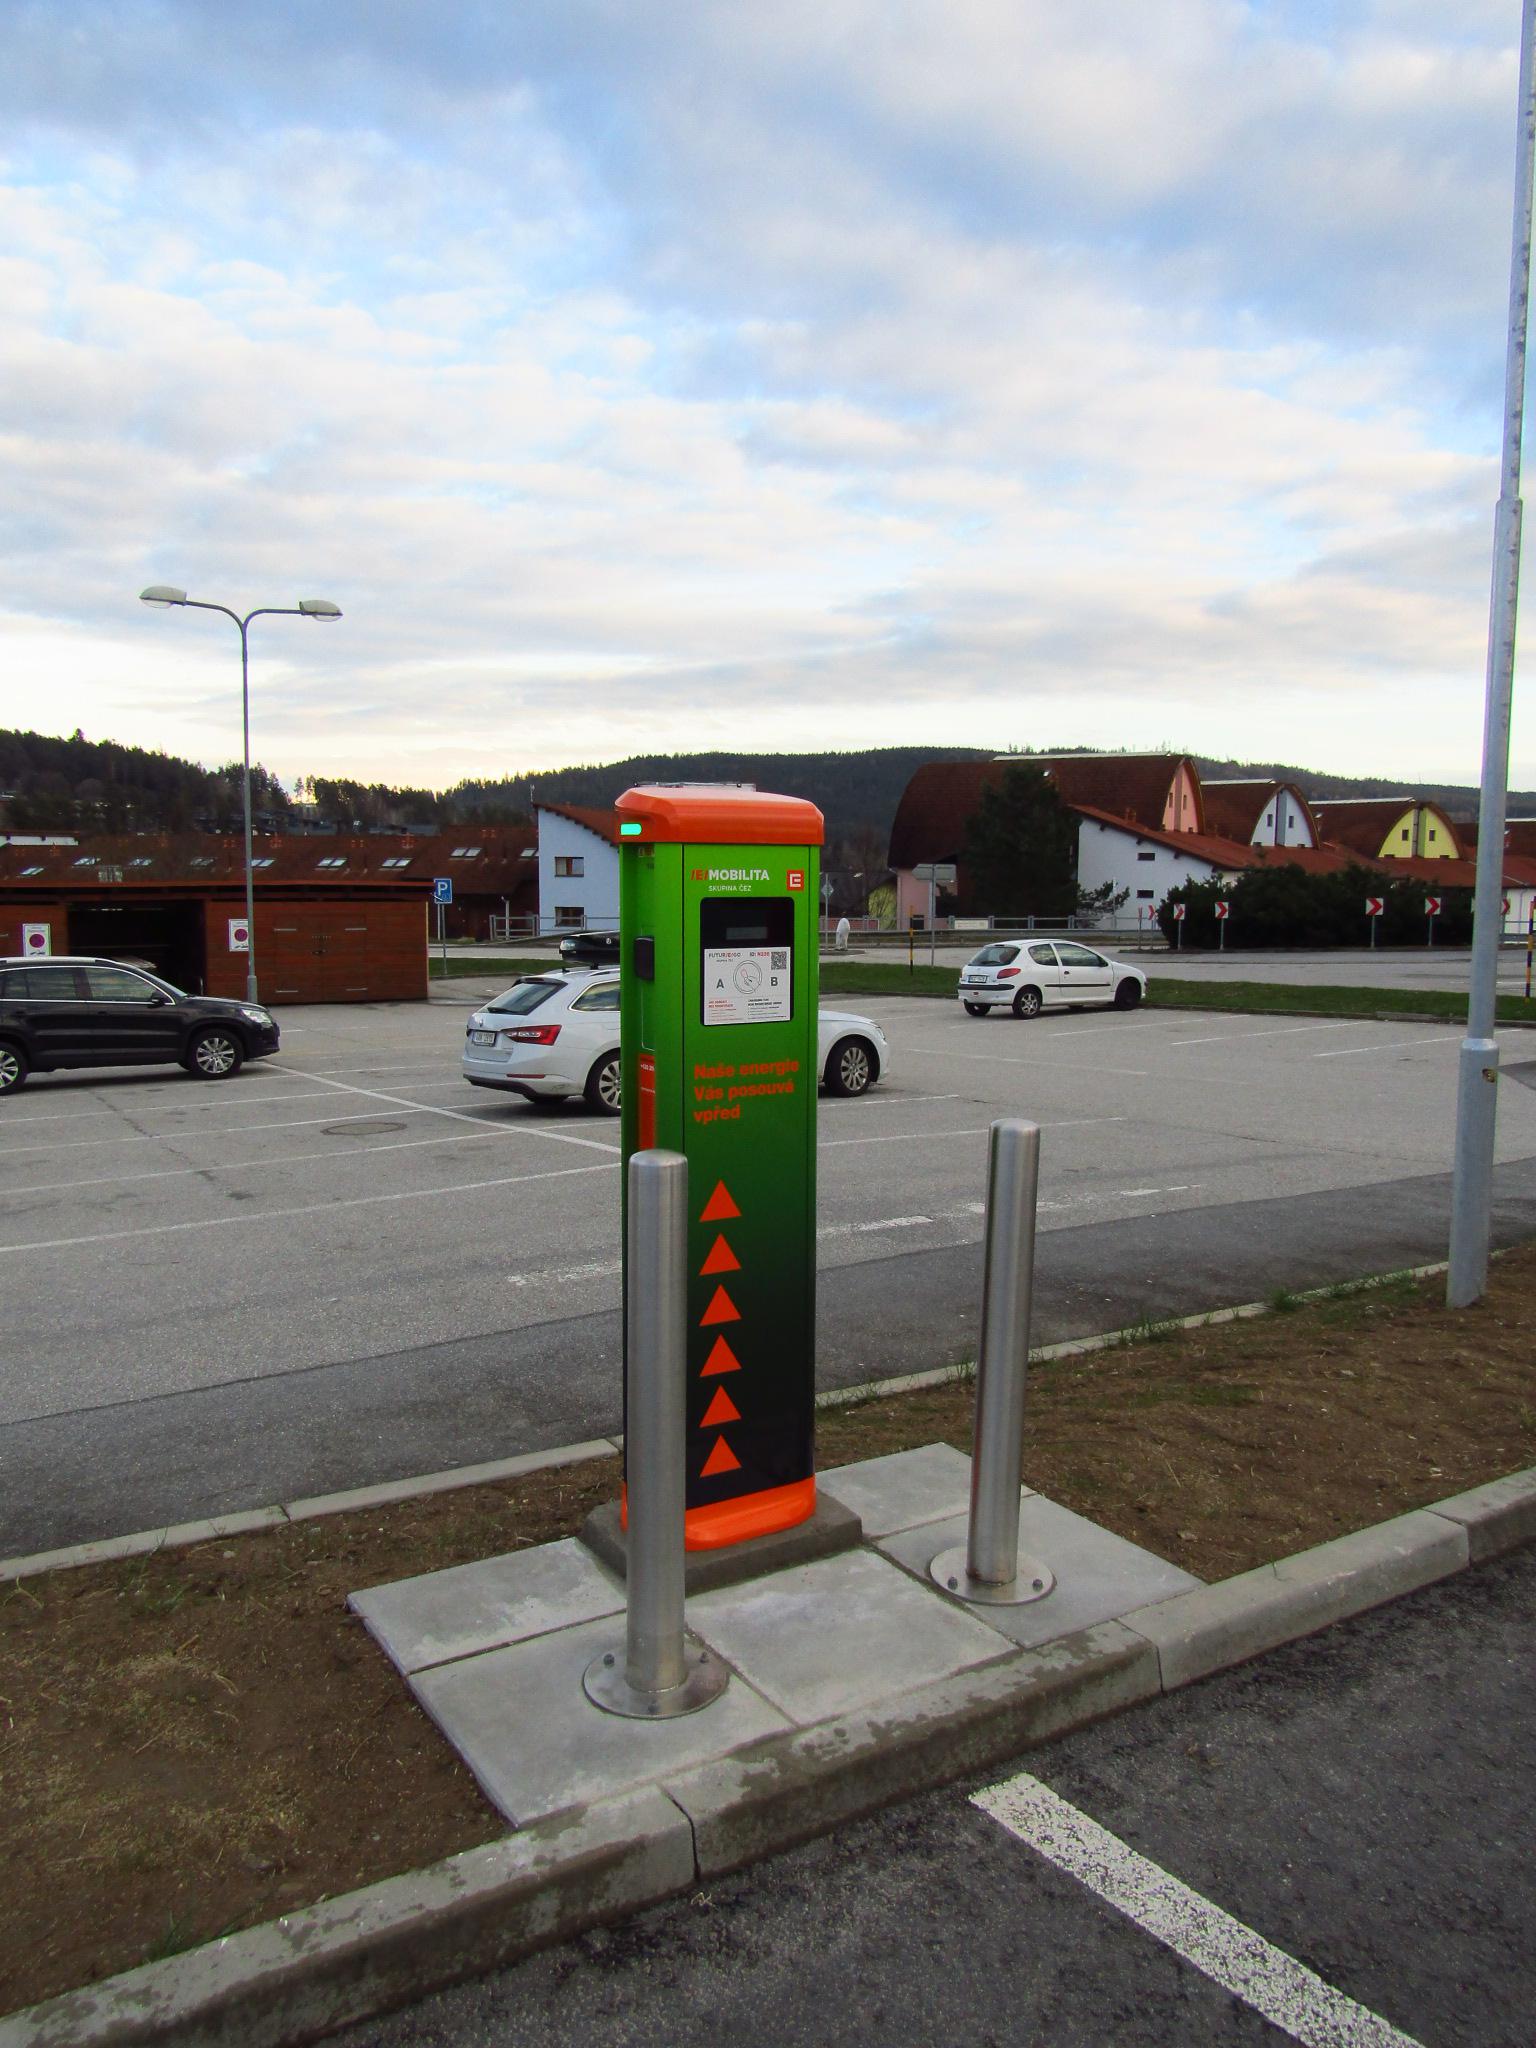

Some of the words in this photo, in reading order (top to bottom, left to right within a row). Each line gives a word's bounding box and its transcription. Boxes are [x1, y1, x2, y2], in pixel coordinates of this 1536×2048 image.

[437, 881, 449, 897] P
[716, 978, 725, 989] A
[770, 976, 779, 987] B
[694, 1062, 735, 1080] Naše
[740, 1059, 799, 1076] energie
[728, 1079, 795, 1103] posouvá
[693, 1103, 741, 1125] vpřed
